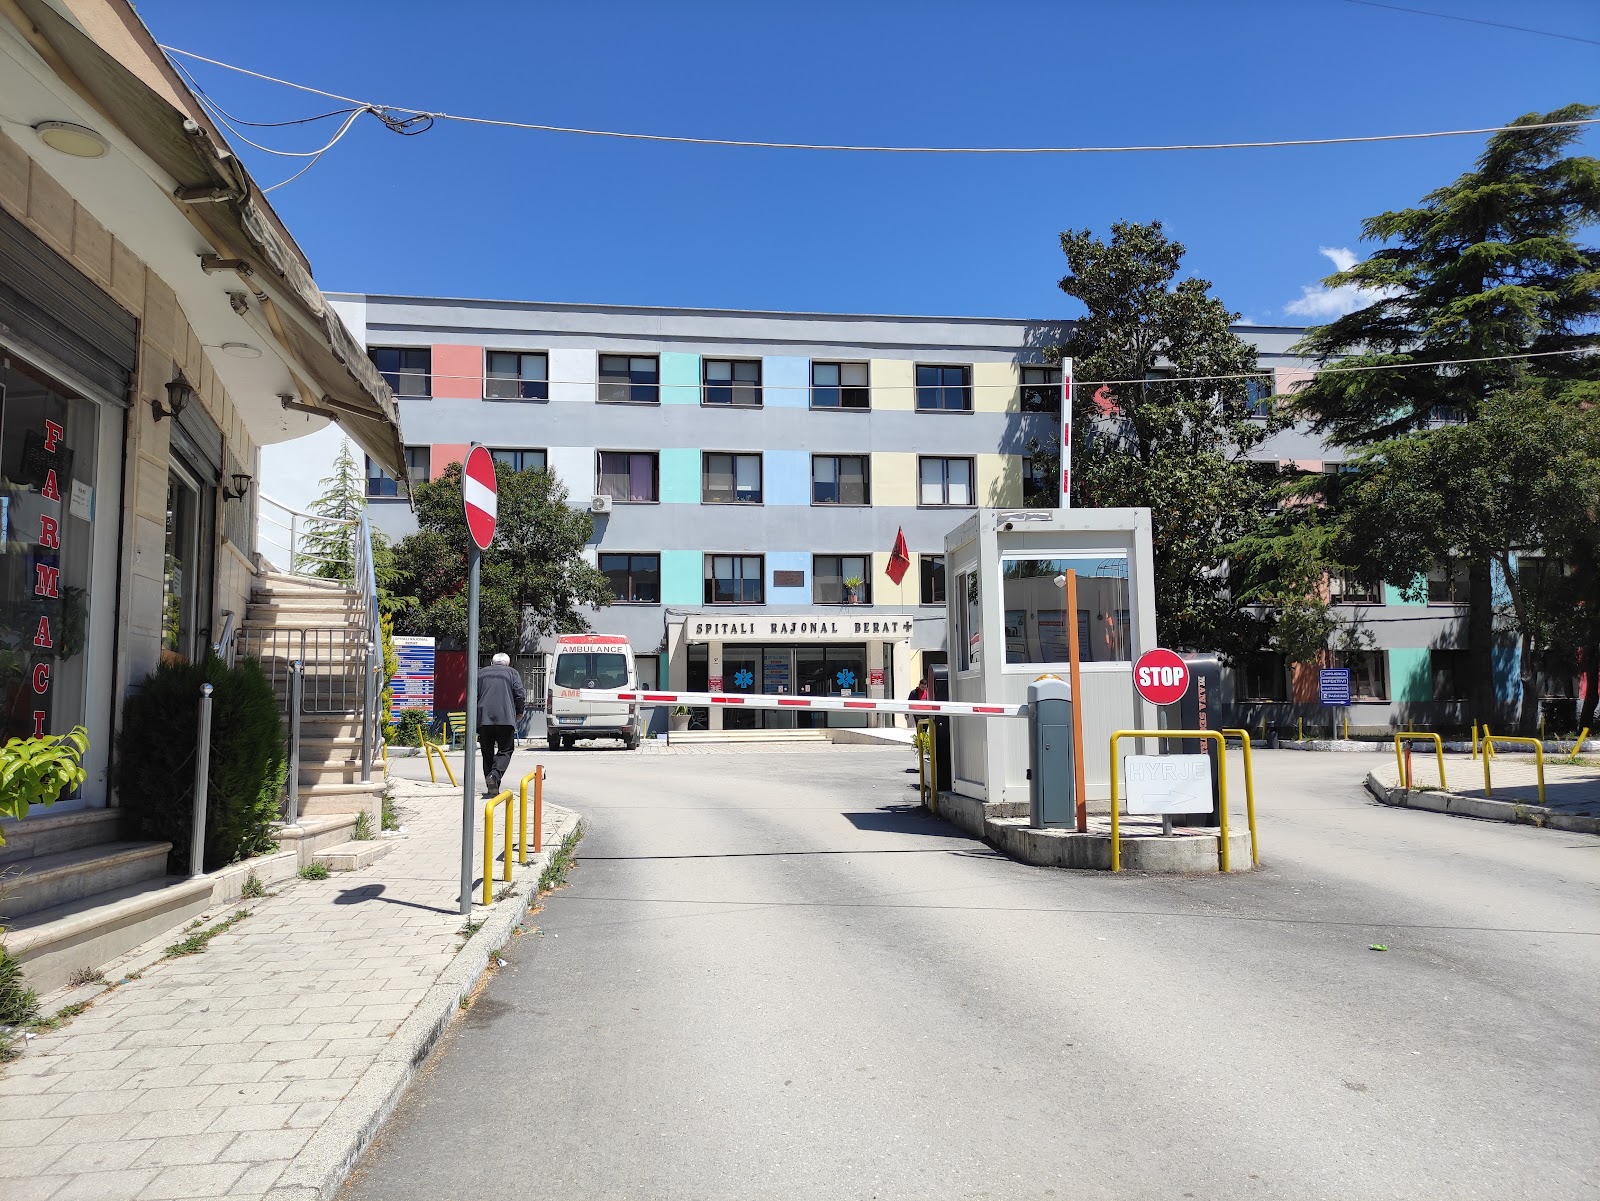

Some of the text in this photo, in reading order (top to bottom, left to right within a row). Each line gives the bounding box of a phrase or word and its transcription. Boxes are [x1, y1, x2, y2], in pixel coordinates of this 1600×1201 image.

[33, 419, 63, 740] FARMACI
[696, 621, 898, 635] SPITALI RAJONAL BERAT
[1139, 666, 1184, 687] STOP
[1197, 676, 1207, 711] MANA
[1129, 762, 1207, 781] HYRJE
